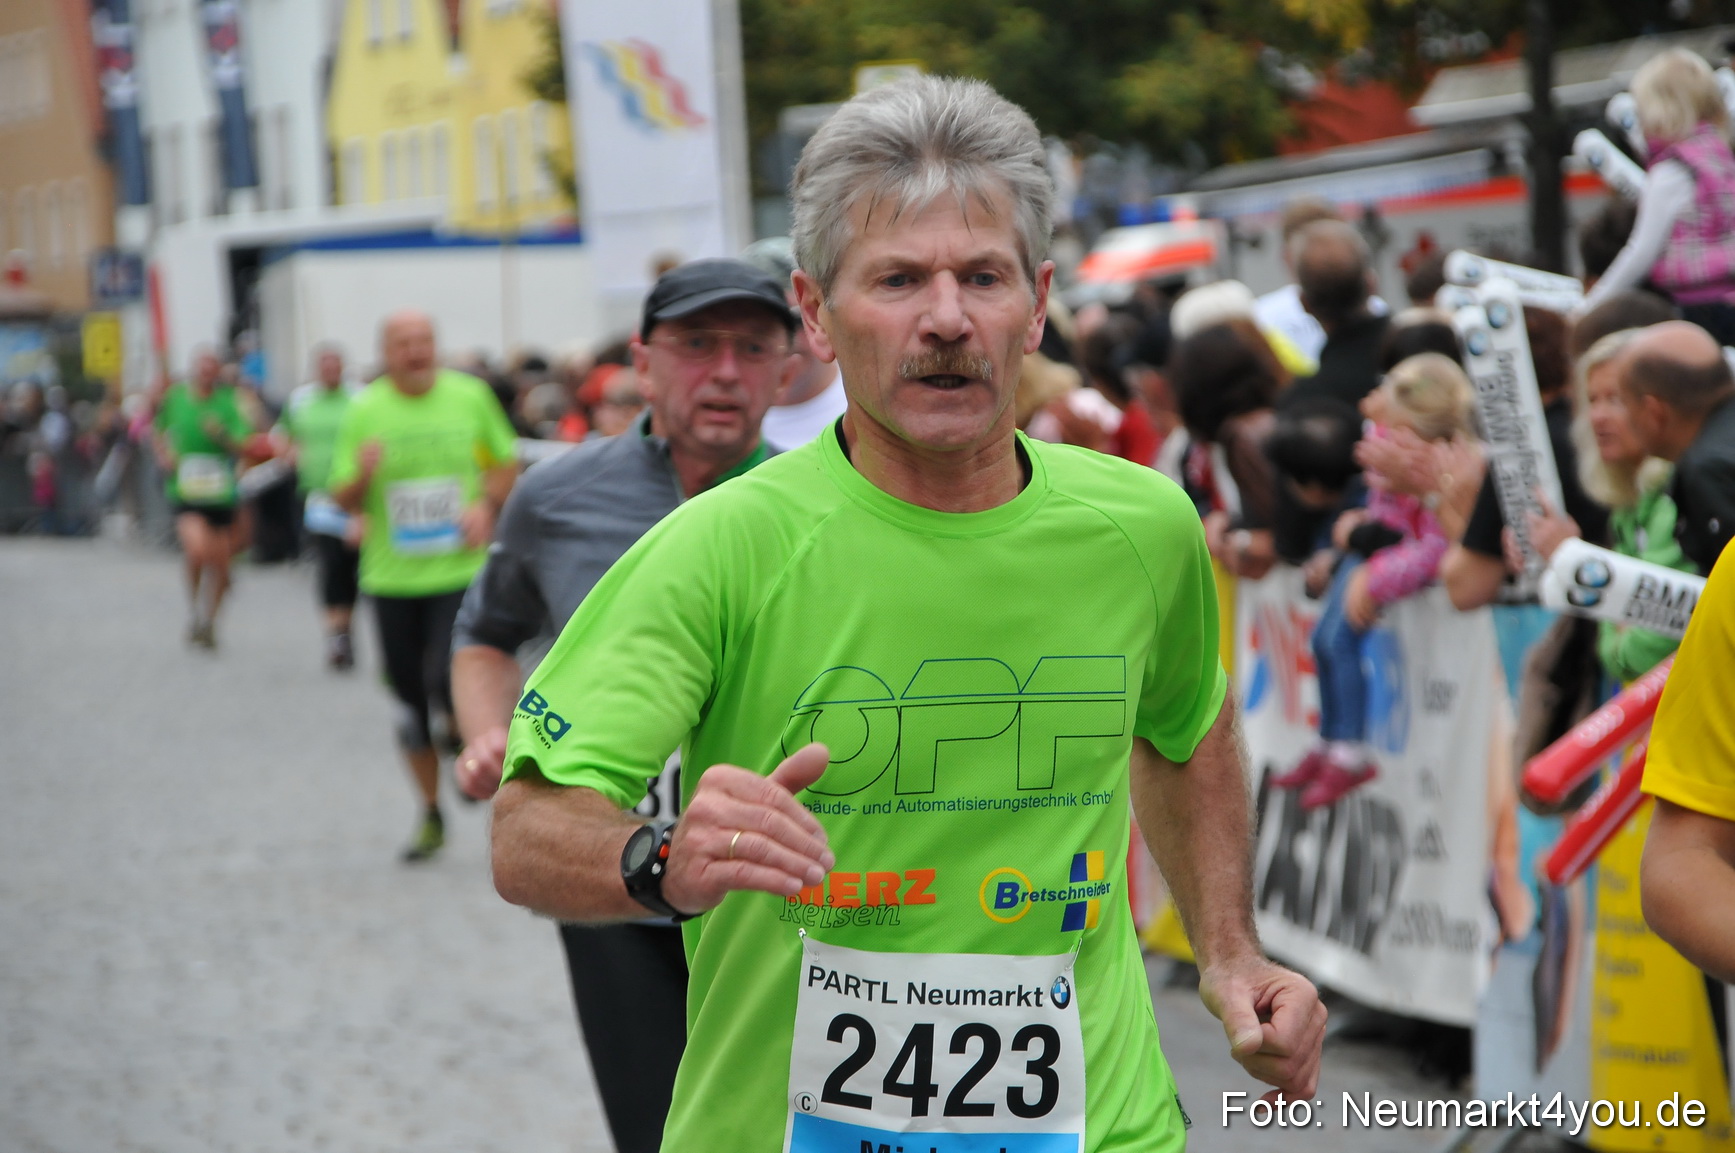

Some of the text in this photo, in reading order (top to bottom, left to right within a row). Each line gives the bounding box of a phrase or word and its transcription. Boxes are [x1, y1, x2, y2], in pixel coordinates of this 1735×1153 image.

[1632, 573, 1701, 616] BM
[519, 688, 572, 742] Ba
[532, 717, 552, 750] Türen
[803, 789, 1114, 815] bäude- und Automatisierungstechnik Gmb
[779, 893, 900, 929] Reisen
[993, 880, 1111, 910] Bretschneider
[807, 965, 1044, 1008] PARTL Neumarkt
[820, 1012, 1061, 1119] 2423
